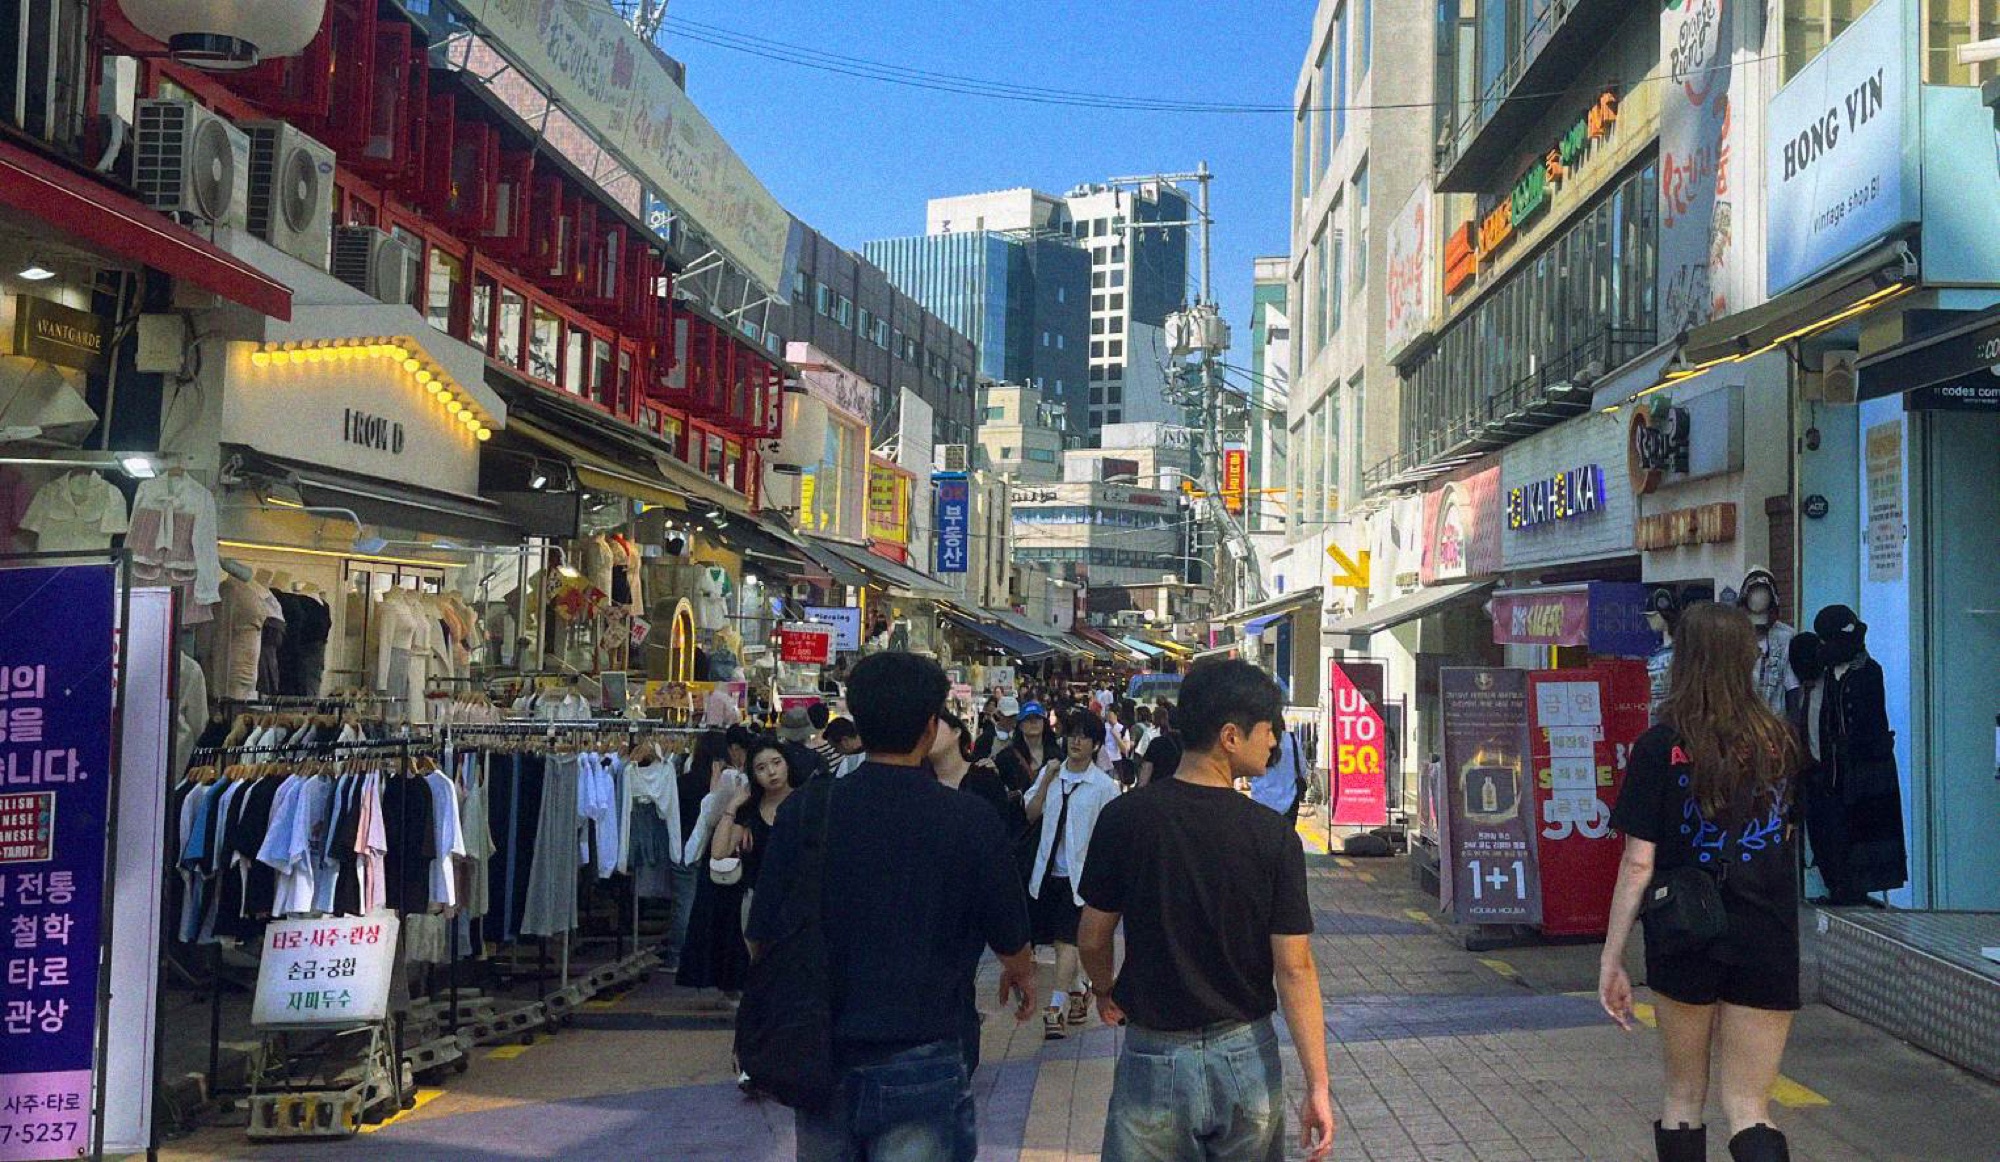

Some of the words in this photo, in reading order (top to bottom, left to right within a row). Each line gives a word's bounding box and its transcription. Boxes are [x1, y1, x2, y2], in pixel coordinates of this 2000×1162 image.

[1783, 106, 1840, 182] HONG
[1845, 67, 1884, 134] VIN
[1813, 201, 1845, 234] vintage
[1848, 183, 1869, 212] shop
[38, 317, 101, 348] AVANTGARDE
[1941, 386, 1975, 397] codes
[392, 422, 404, 455] D
[1506, 481, 1547, 530] HOLIKA
[1547, 463, 1597, 519] HOLIKA
[943, 504, 963, 569] 부동산
[0, 664, 46, 700] 의
[0, 706, 43, 742] 을
[1339, 715, 1376, 741] TO
[0, 747, 88, 786] 니다.
[1538, 765, 1614, 789] SE
[16, 870, 76, 905] 전통
[1468, 860, 1526, 900] 1+1
[11, 912, 74, 948] 철학
[8, 957, 70, 990] 타로
[4, 997, 69, 1034] 관상
[286, 988, 351, 1011] 자미두수
